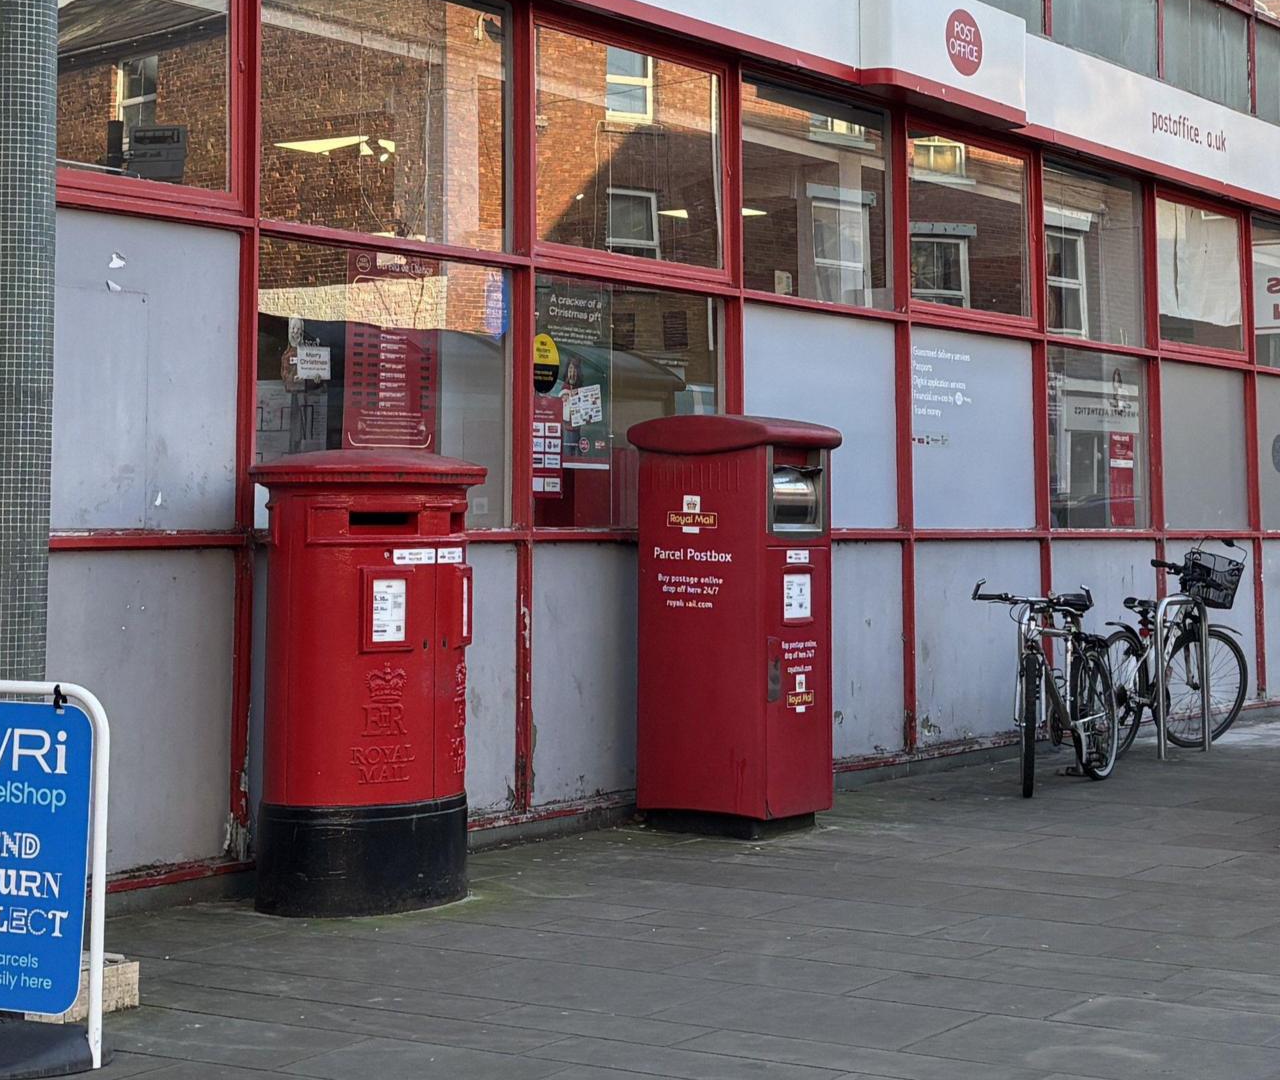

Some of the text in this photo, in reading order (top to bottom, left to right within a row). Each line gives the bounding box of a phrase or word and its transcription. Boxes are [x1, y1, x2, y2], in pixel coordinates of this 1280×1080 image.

[954, 21, 975, 42] POST
[950, 38, 978, 62] OFFICE
[550, 294, 556, 303] A
[558, 296, 585, 306] cracker
[549, 307, 587, 319] Christmas
[670, 514, 714, 524] Royal Mail
[654, 547, 732, 562] Parcel Postbox
[658, 573, 670, 582] Buy
[671, 575, 698, 584] postage
[663, 585, 719, 595] drop off here 24/7
[349, 745, 416, 765] ROYAL
[358, 764, 410, 785] MAIL
[21, 974, 52, 989] here
